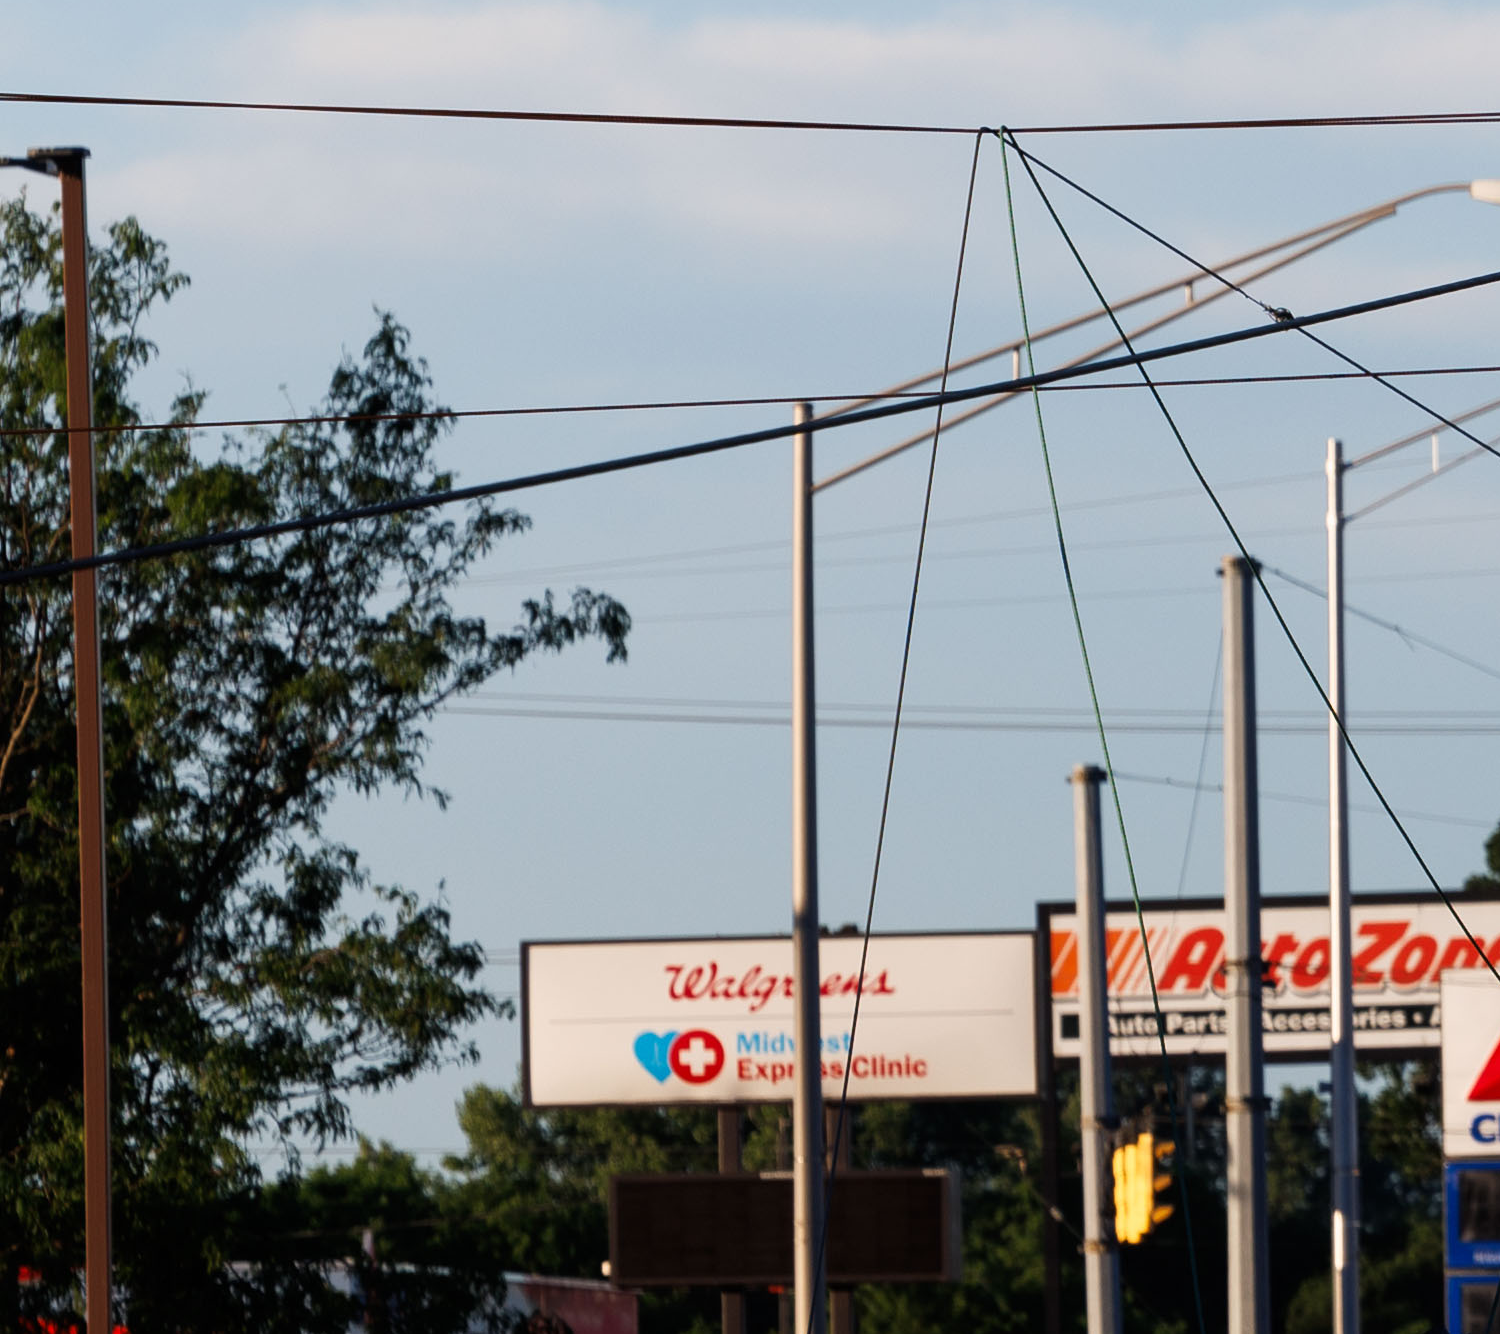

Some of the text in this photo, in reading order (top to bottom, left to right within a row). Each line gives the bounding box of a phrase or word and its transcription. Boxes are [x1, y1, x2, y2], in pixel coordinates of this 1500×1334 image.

[664, 961, 896, 1013] Walgrens
[1262, 1008, 1407, 1033] Accesories
[852, 1054, 928, 1078] Clinic
